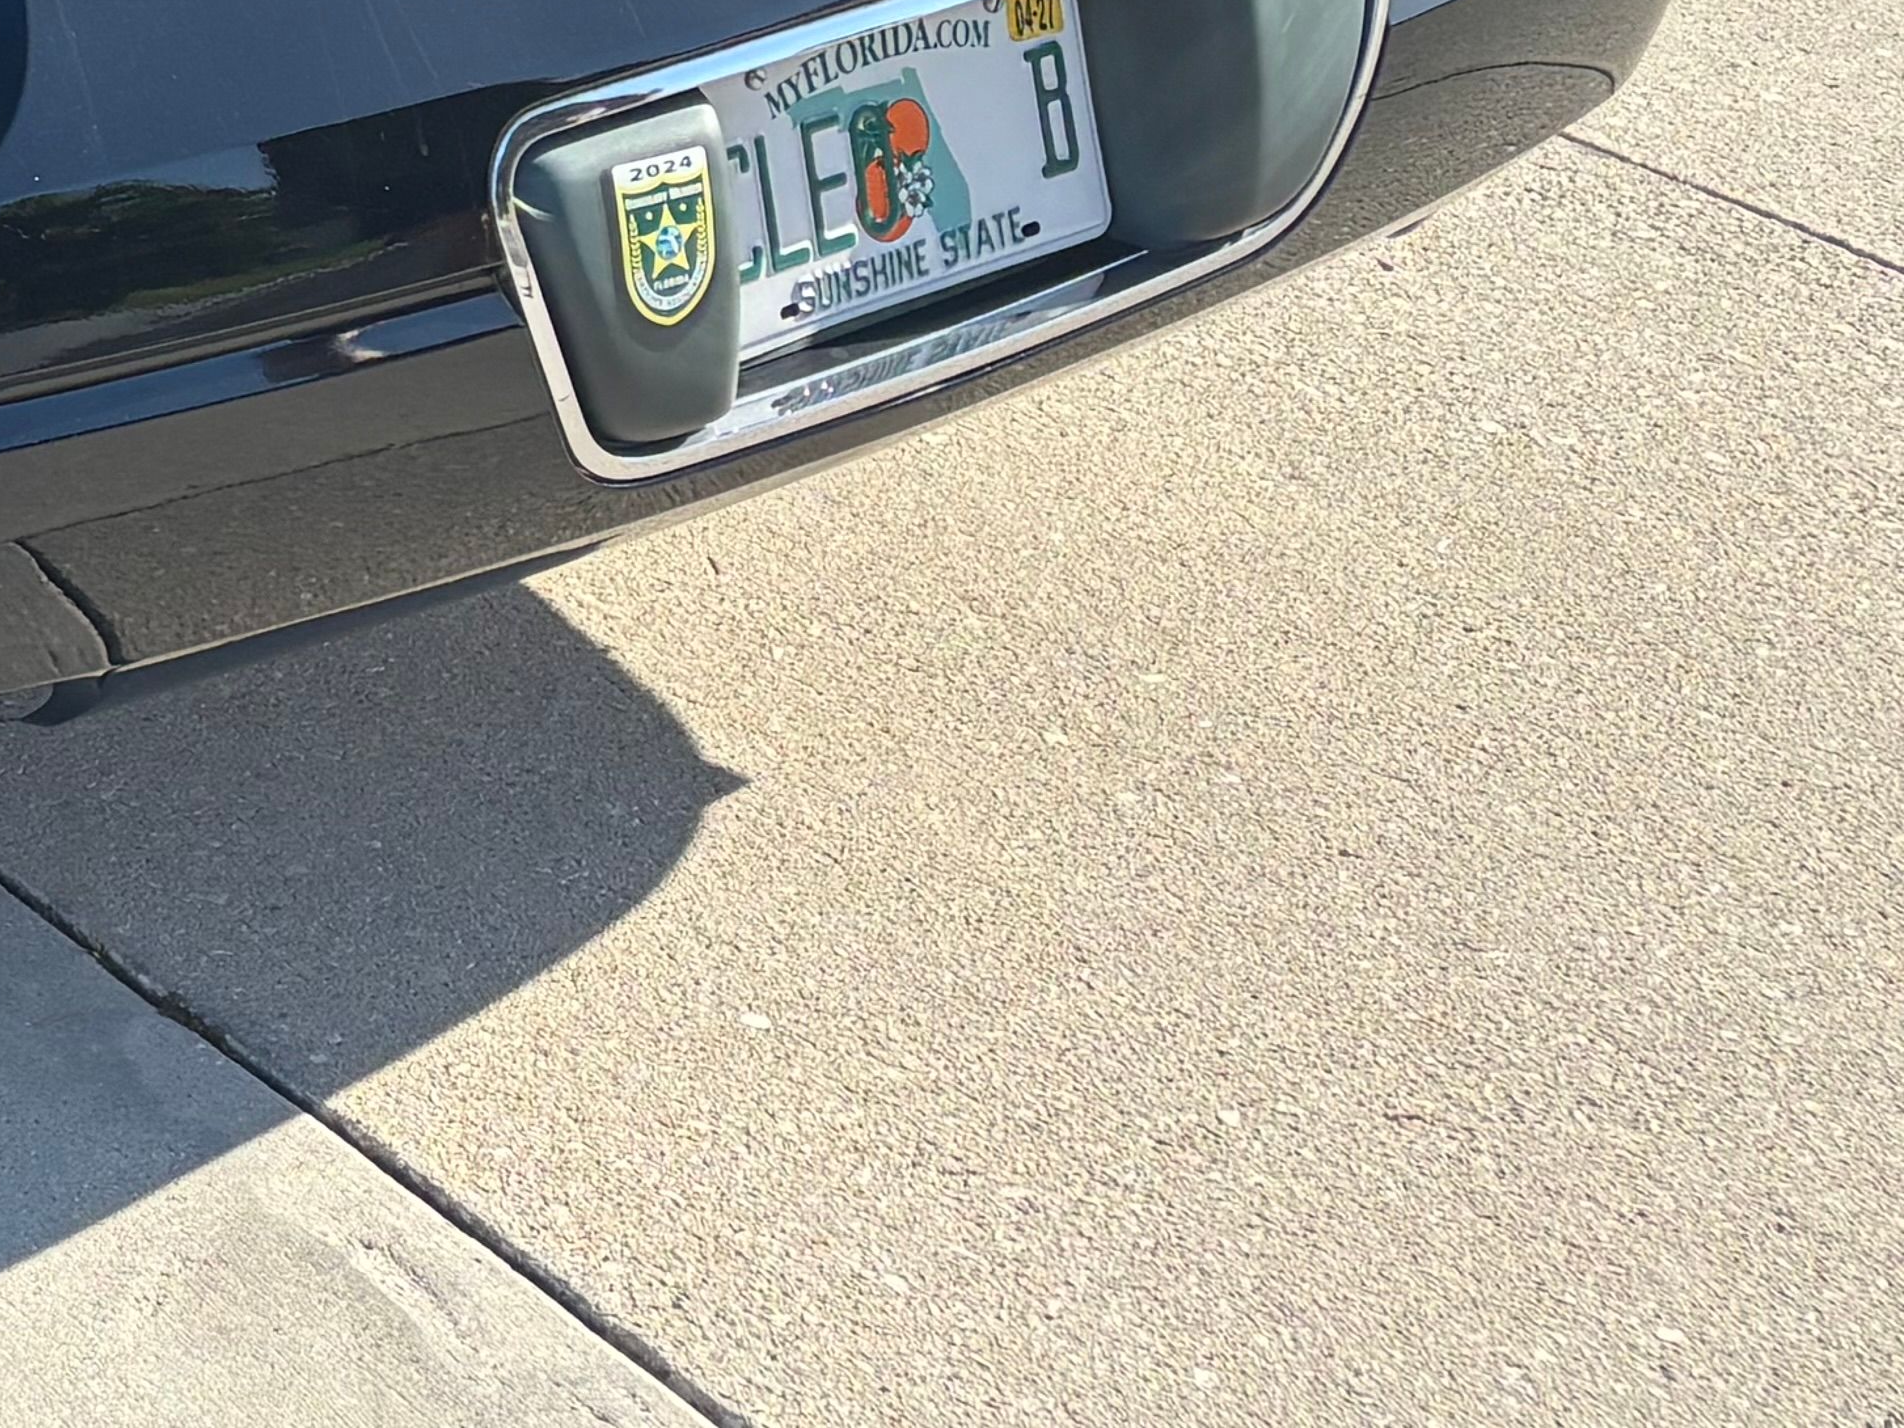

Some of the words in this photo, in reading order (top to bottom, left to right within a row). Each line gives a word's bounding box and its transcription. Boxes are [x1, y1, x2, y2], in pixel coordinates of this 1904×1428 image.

[763, 17, 991, 121] MYFLORIDA.COM
[1022, 40, 1080, 180] B
[629, 155, 693, 182] 2024
[790, 238, 930, 321] SUNSHINE
[939, 205, 1026, 268] STATE
